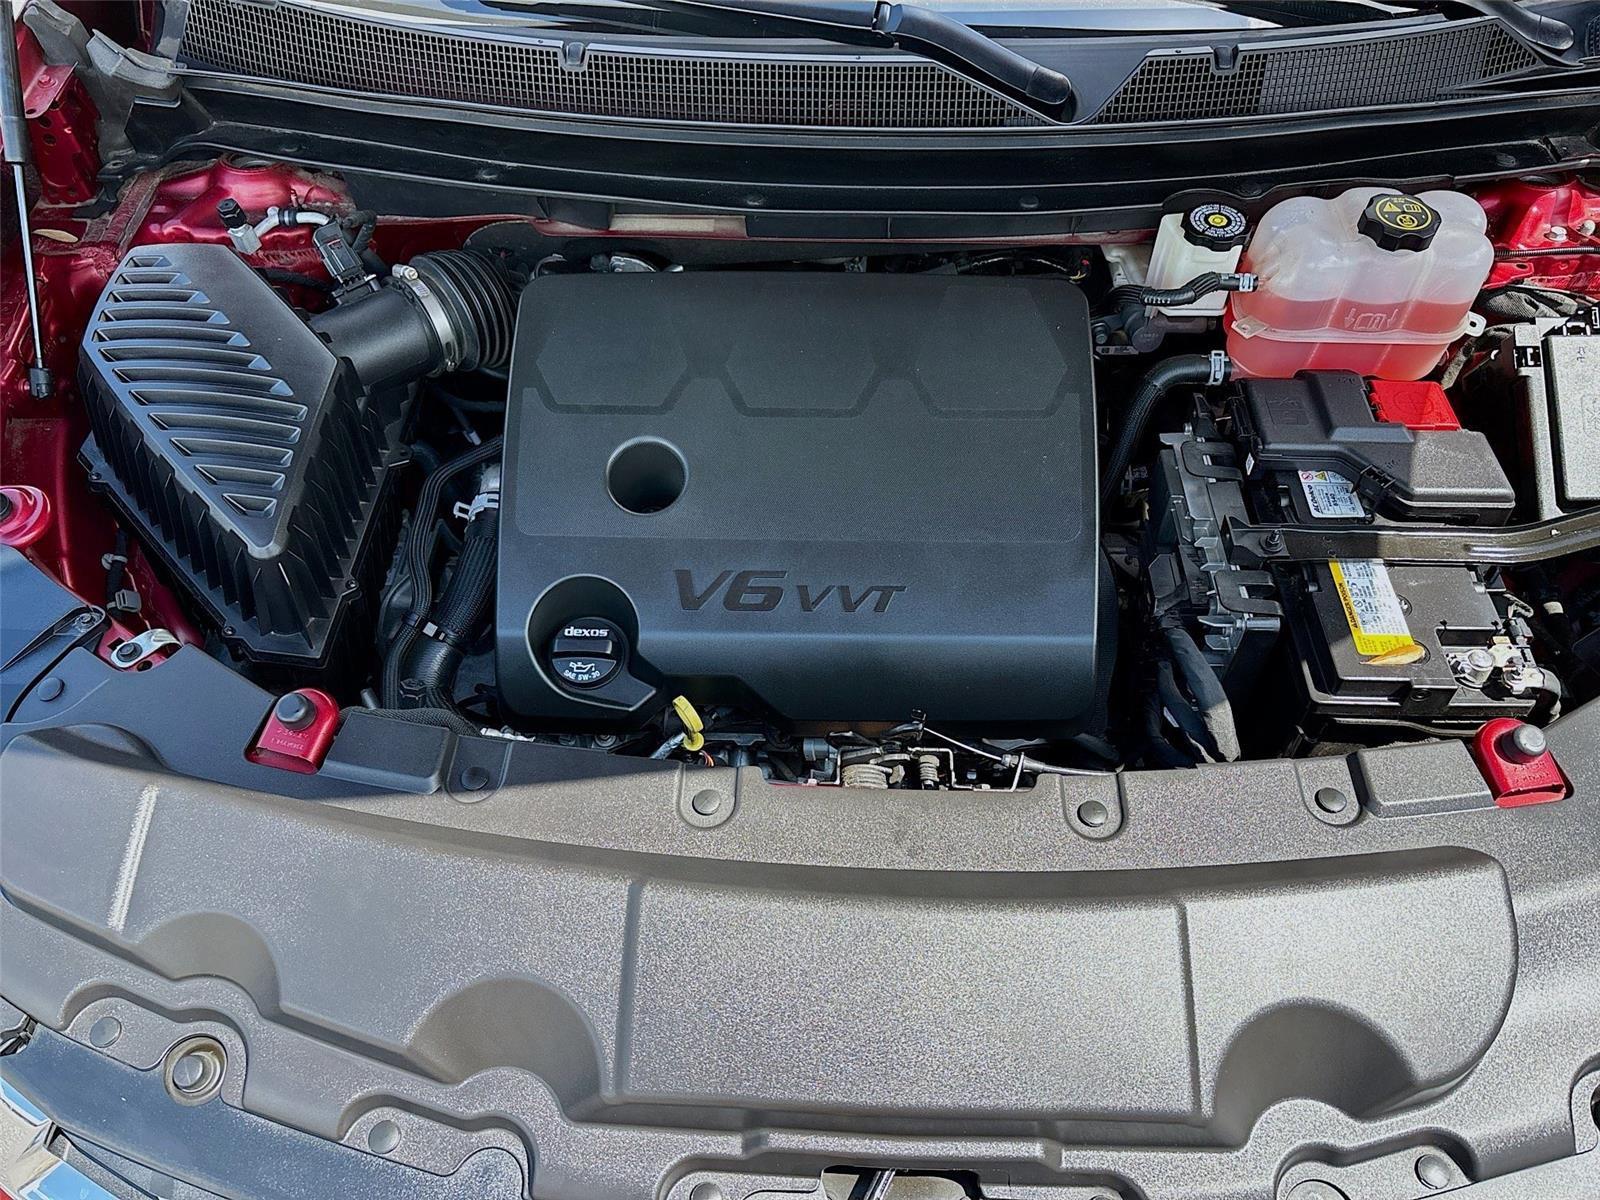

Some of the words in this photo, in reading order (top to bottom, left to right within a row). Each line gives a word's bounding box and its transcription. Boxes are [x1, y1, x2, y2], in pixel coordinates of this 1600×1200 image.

[673, 569, 787, 612] V6
[796, 584, 907, 613] VVT
[564, 626, 609, 637] dexos
[563, 669, 577, 680] SAE
[577, 670, 601, 681] 5W-30
